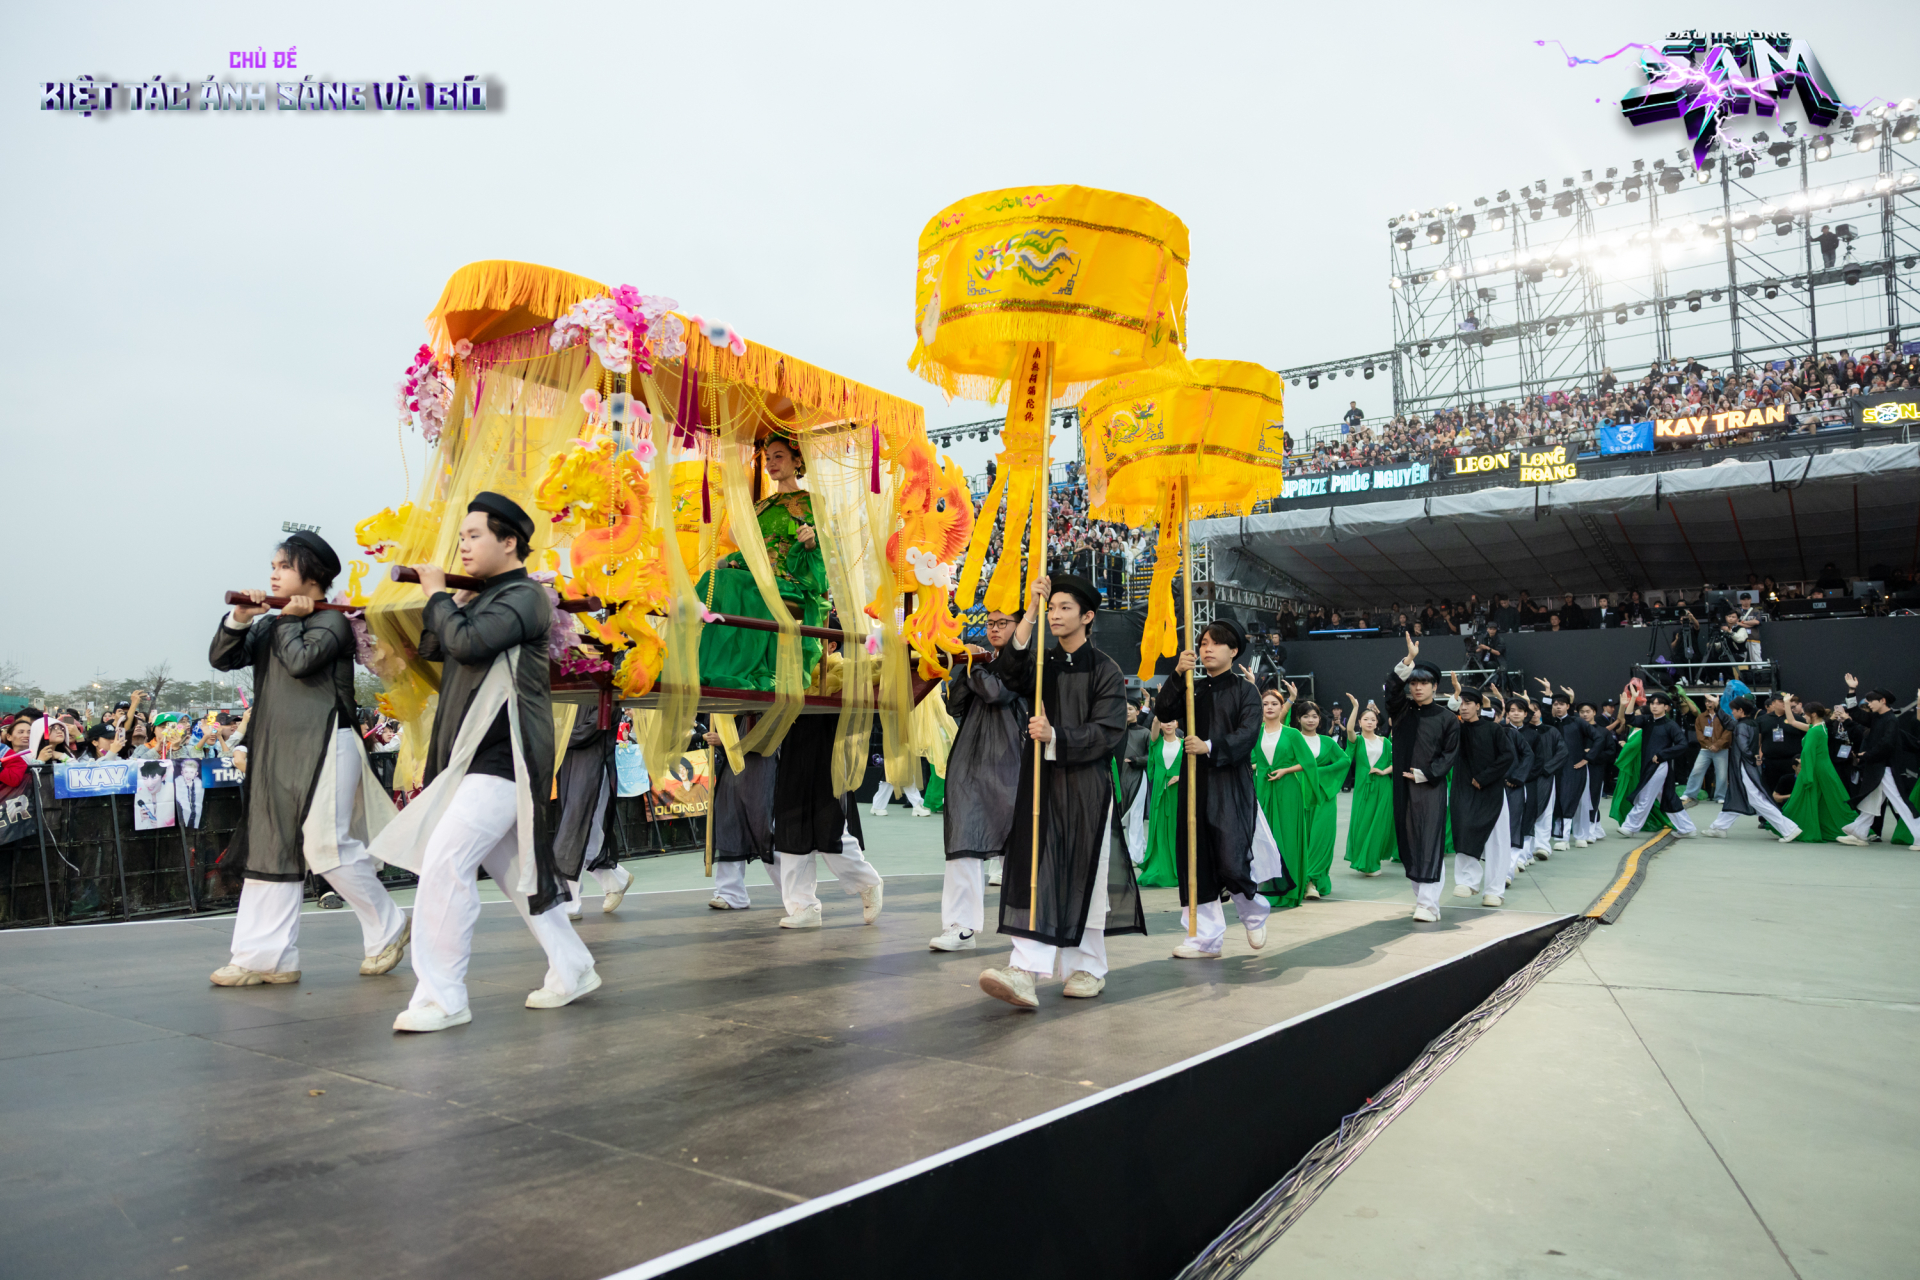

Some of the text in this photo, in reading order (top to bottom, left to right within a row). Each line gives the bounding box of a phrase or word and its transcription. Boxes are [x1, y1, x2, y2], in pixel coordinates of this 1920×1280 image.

[1655, 404, 1786, 437] KAY TRAN
[1455, 452, 1511, 475] LEON
[1520, 446, 1566, 467] LONG
[1280, 476, 1329, 499] UPRIZE
[1330, 469, 1371, 494] PHÚC
[69, 766, 127, 789] KAY
[212, 768, 246, 784] THẠ
